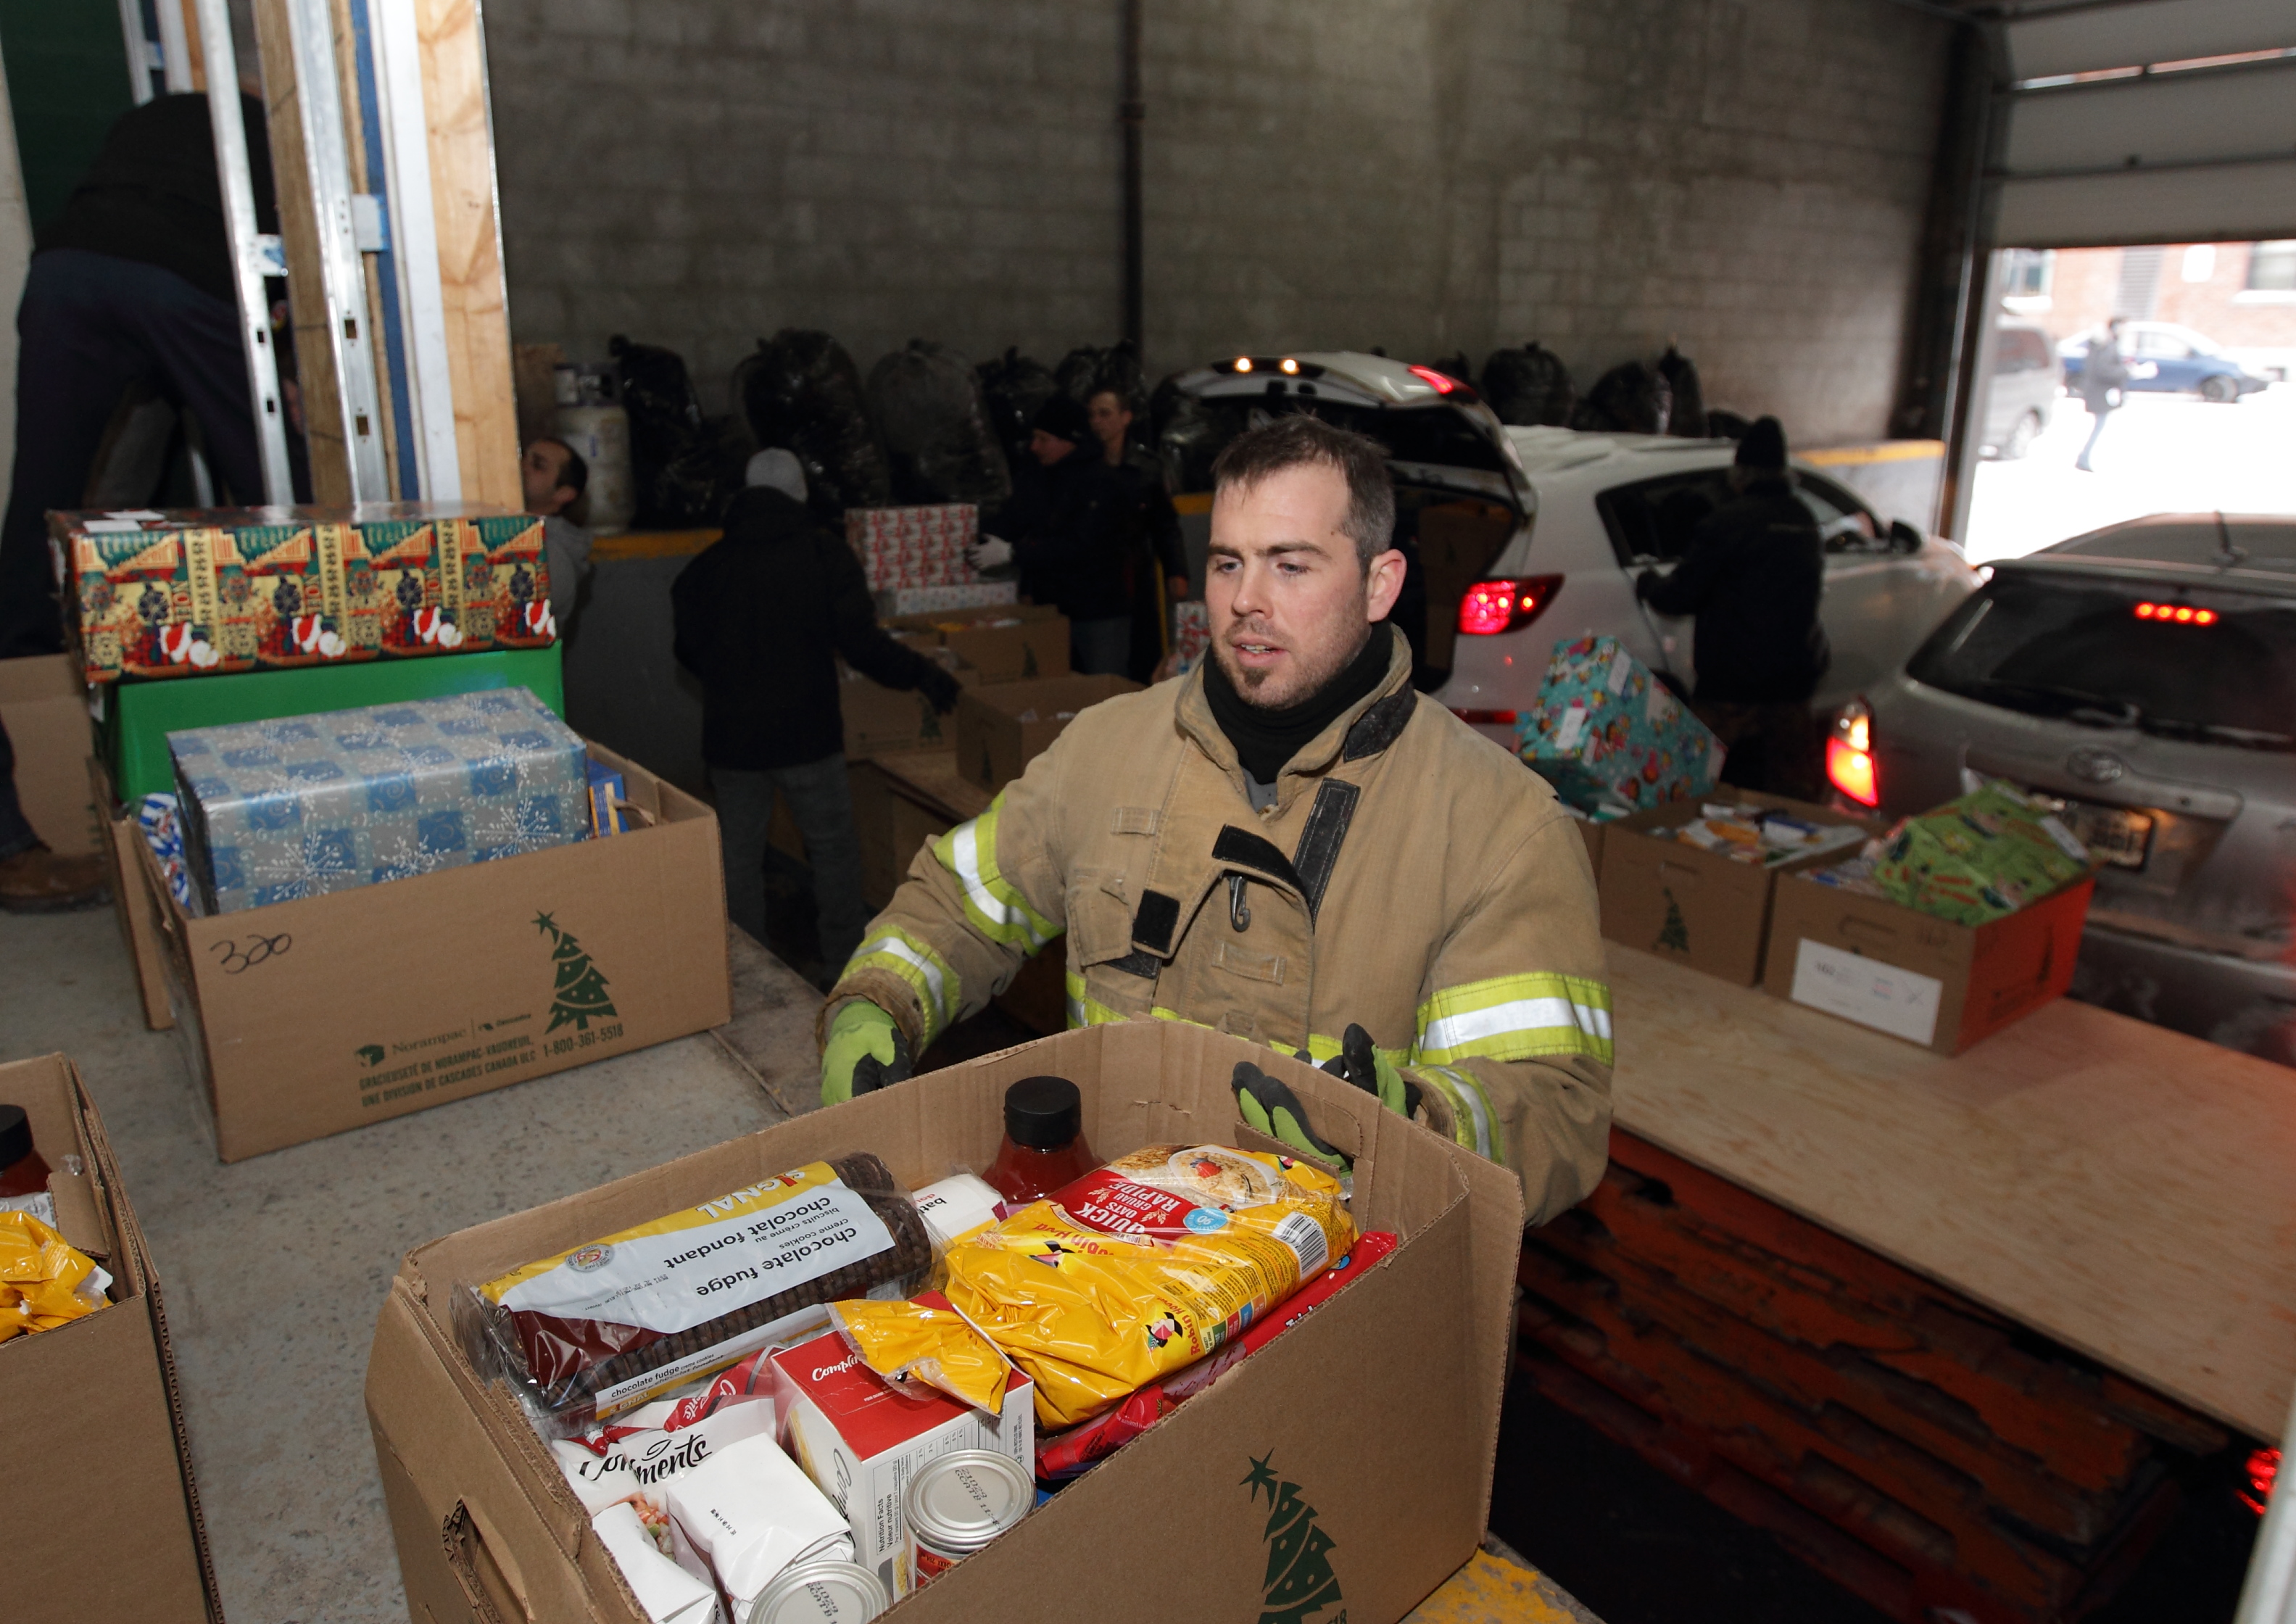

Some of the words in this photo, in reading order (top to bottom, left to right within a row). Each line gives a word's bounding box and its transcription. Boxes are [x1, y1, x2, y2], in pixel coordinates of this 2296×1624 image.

[209, 931, 293, 975] 320
[544, 1024, 623, 1057] 1-800-361-5518
[383, 1082, 423, 1101] DIVISION
[484, 1055, 518, 1073] CANADA
[1106, 1202, 1138, 1218] OATS
[1109, 1181, 1181, 1213] RAPIDE
[1114, 1193, 1152, 1211] GRUAU
[746, 1197, 832, 1235] chocolat
[768, 1220, 801, 1240] crème
[800, 1206, 840, 1227] biscuits
[817, 1217, 850, 1236] creme
[1074, 1202, 1145, 1235] QUICK
[1196, 1212, 1214, 1227] 90
[663, 1234, 745, 1269] fondant
[753, 1233, 768, 1245] au
[761, 1227, 856, 1272] chocolate
[777, 1230, 818, 1252] cookies
[696, 1264, 759, 1296] fudge
[1182, 1314, 1201, 1355] Robin
[611, 1378, 653, 1398] chocolate
[655, 1365, 680, 1381] fudge
[695, 1353, 716, 1364] cookies
[961, 1466, 987, 1500] 21029
